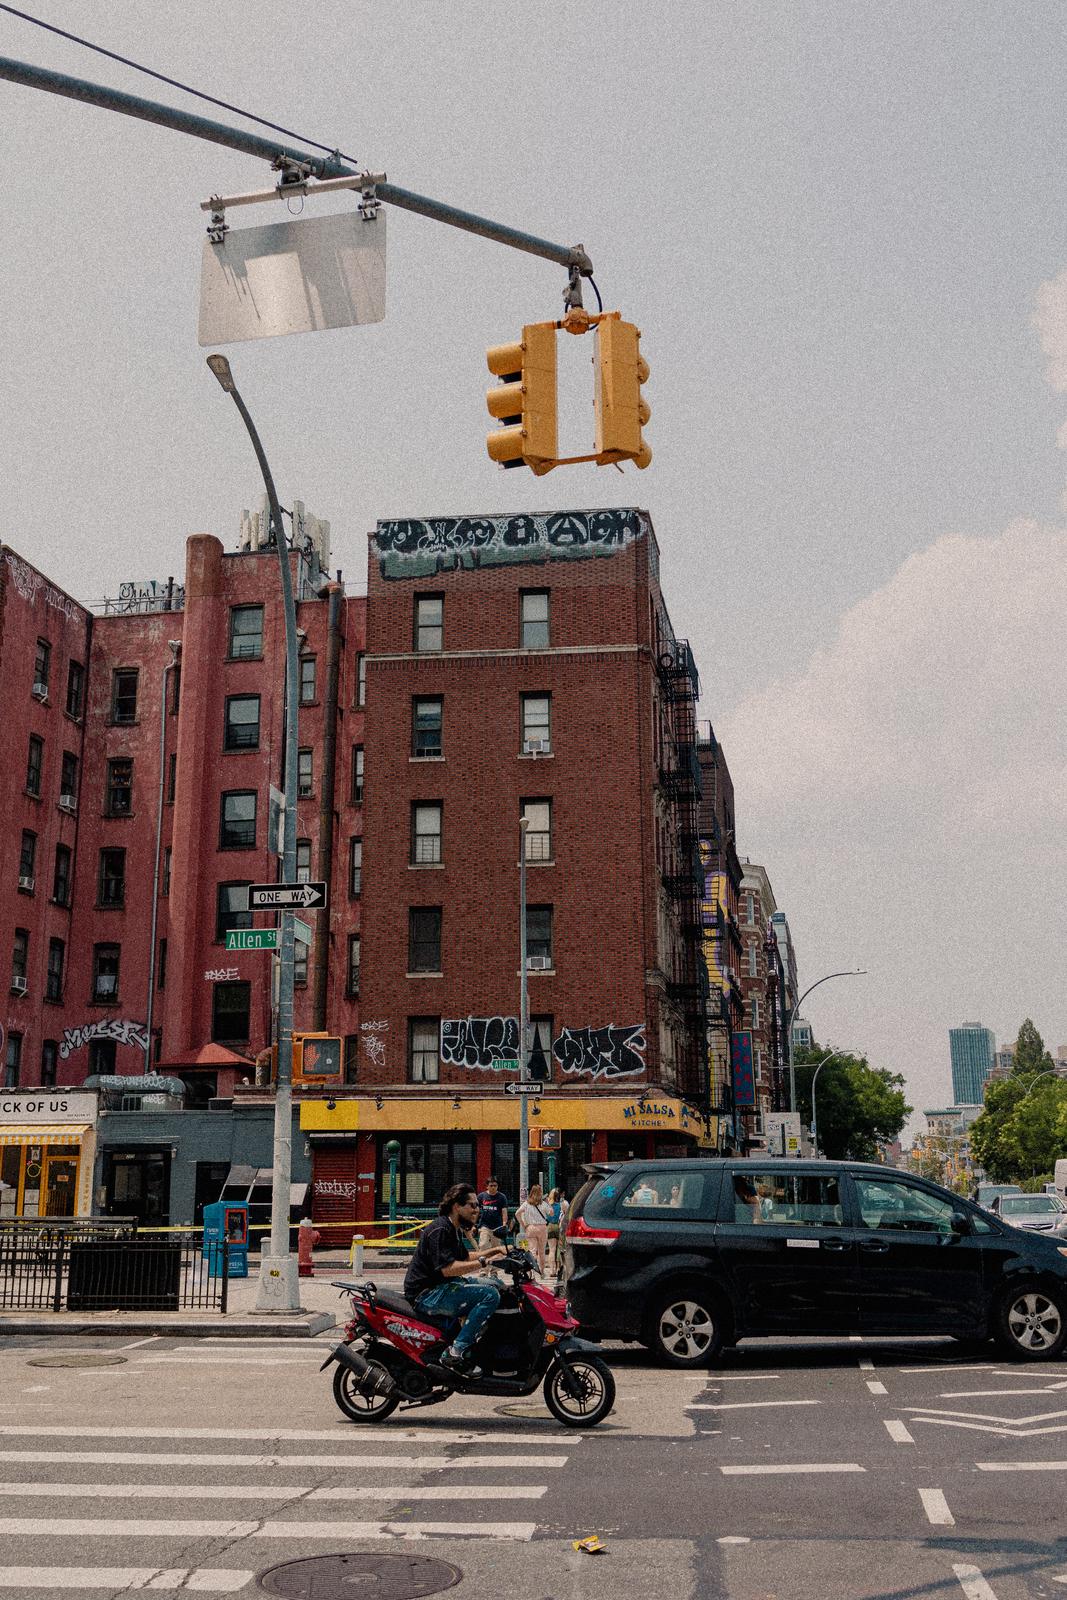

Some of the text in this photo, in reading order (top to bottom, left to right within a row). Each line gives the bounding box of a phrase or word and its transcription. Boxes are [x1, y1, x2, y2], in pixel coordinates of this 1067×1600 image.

[259, 891, 314, 902] ONE WAY
[229, 931, 277, 948] Allen St
[494, 1060, 512, 1069] Allen
[0, 1101, 68, 1113] CK OF US
[623, 1105, 637, 1118] MI
[639, 1103, 676, 1118] SALSA
